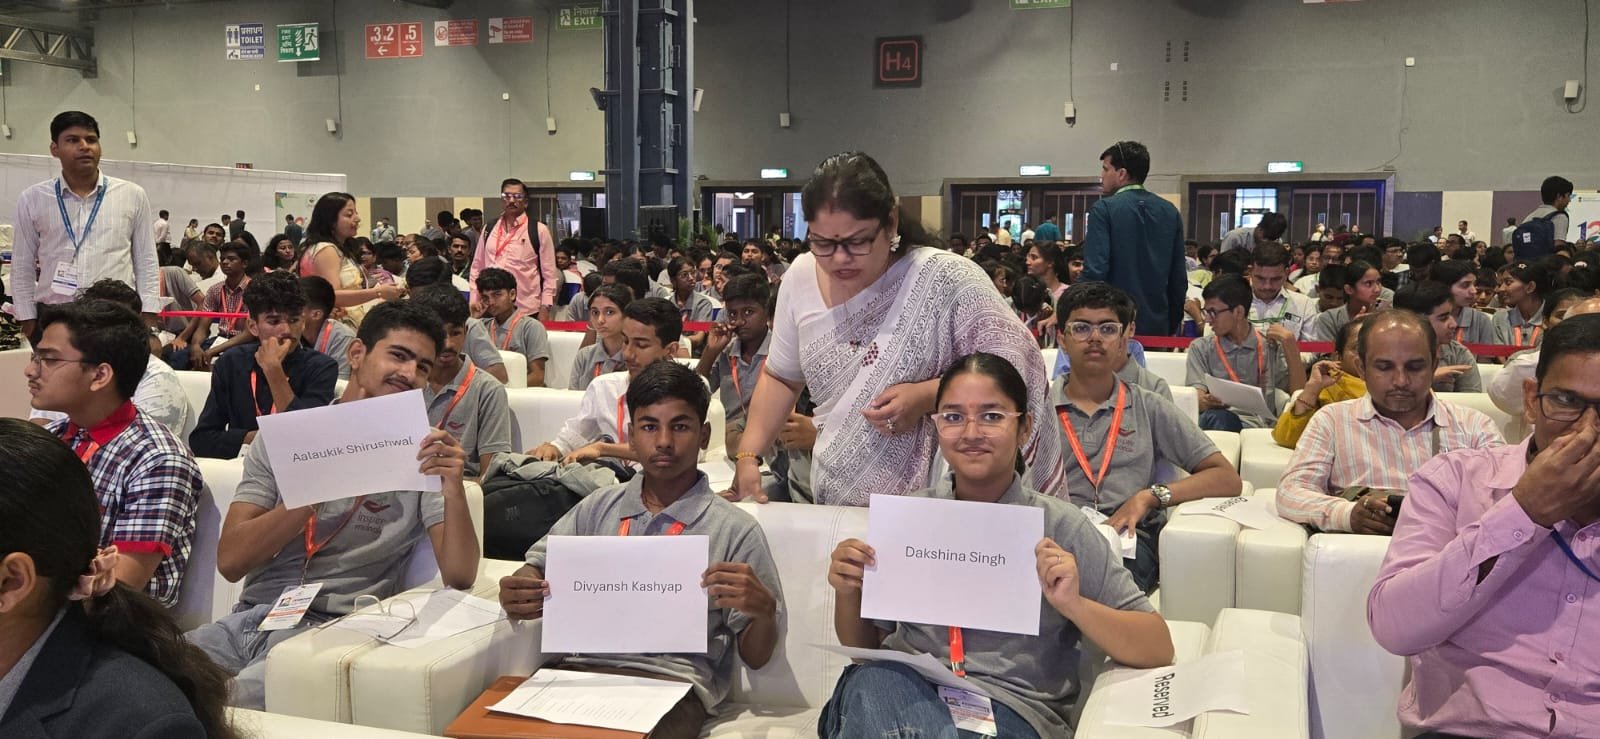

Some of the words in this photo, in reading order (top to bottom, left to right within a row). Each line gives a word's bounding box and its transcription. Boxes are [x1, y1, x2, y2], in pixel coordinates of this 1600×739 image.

[574, 16, 594, 25] EXIT
[240, 36, 263, 44] TOILET
[886, 51, 912, 70] H4
[292, 447, 344, 462] Aalaukik
[346, 436, 414, 454] Shirushwal
[905, 545, 966, 562] Dakshina
[969, 551, 1006, 567] Singh
[573, 580, 628, 594] Divyansh
[631, 580, 683, 594] Kashyap
[1152, 672, 1176, 718] Reserved
